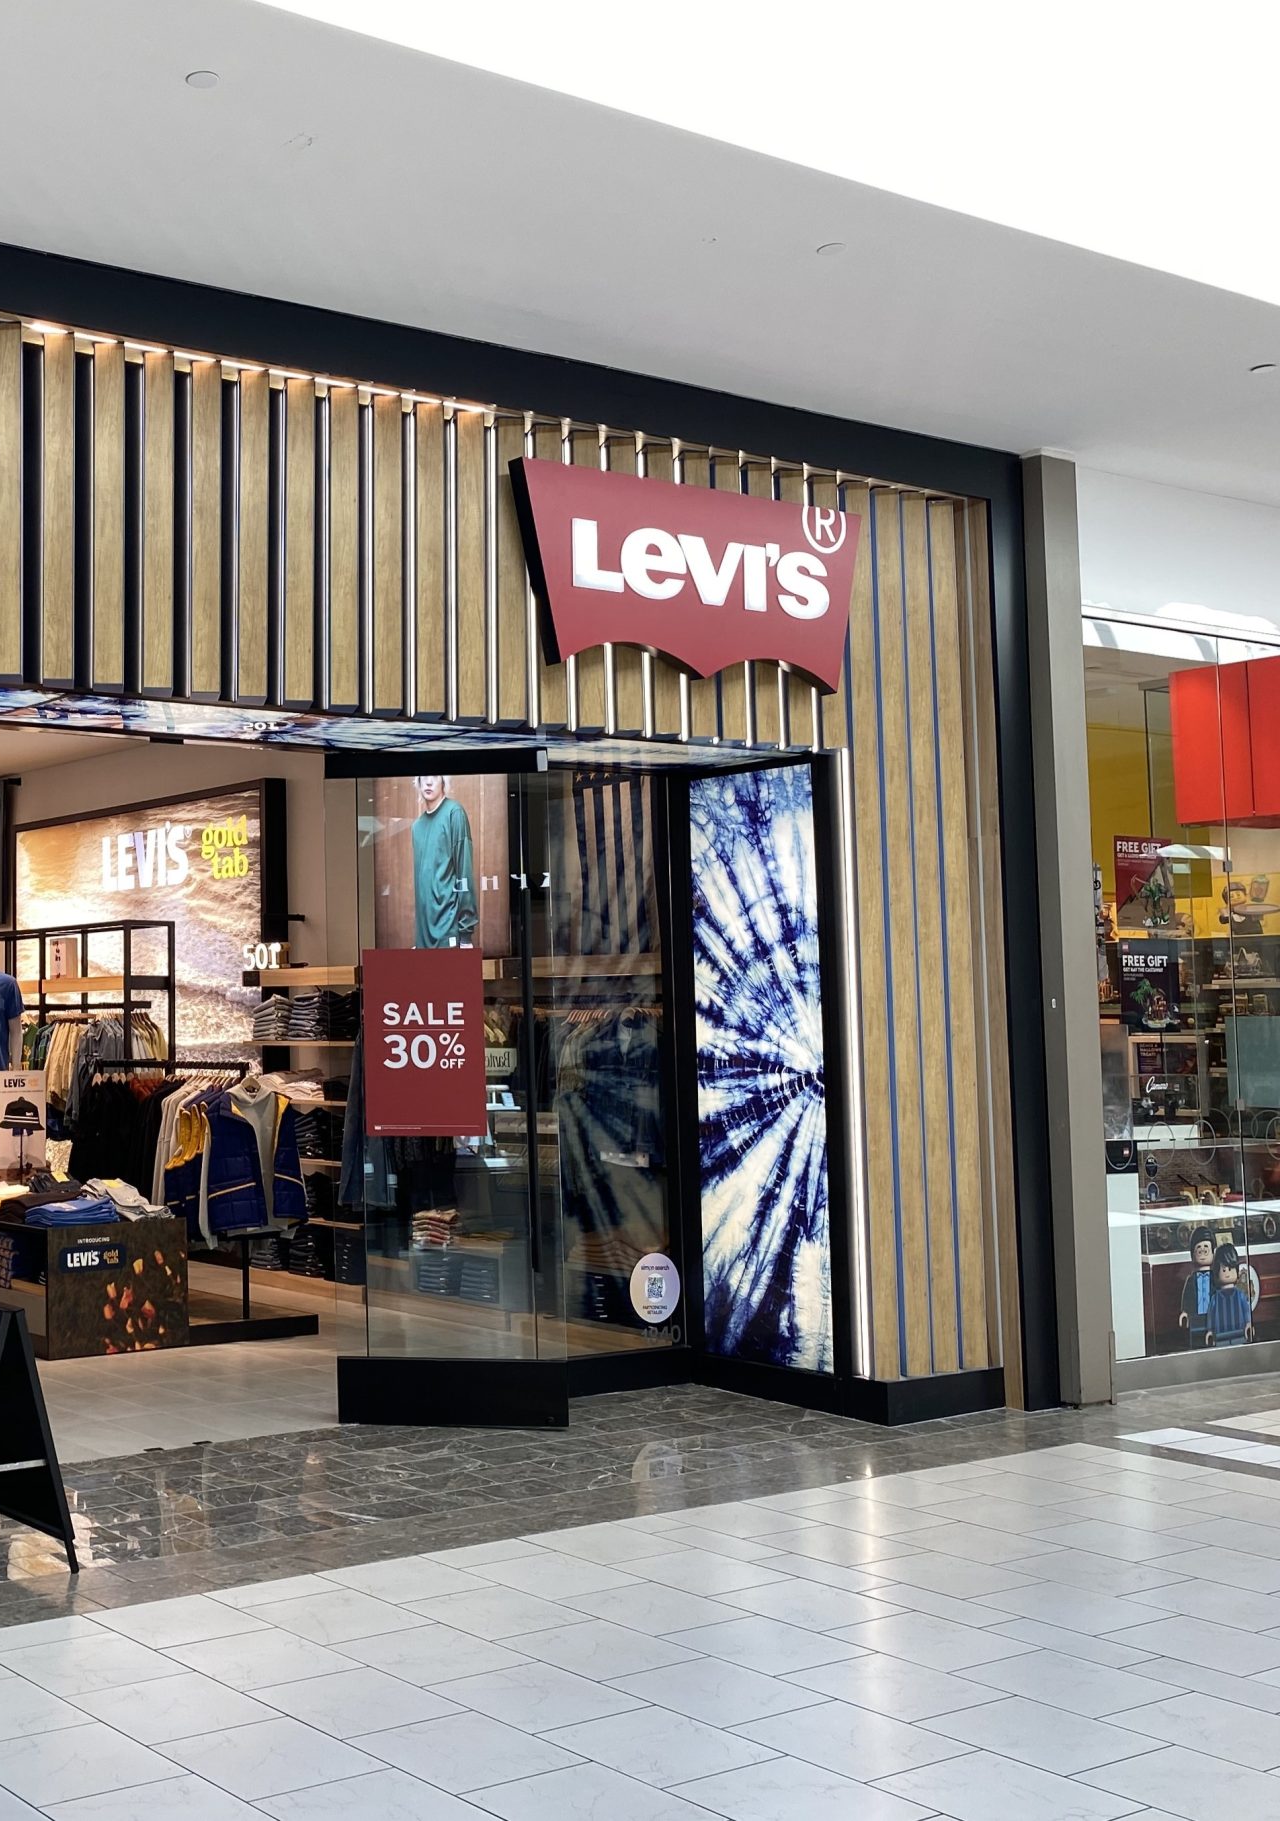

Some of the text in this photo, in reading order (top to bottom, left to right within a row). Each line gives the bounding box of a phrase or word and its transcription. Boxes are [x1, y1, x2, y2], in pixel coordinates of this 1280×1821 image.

[201, 814, 248, 859] gold
[1116, 841, 1140, 853] FREE
[211, 847, 249, 880] tab
[243, 942, 281, 970] 501
[1122, 955, 1168, 967] FREE GIFT
[383, 1002, 465, 1026] SALE
[440, 1059, 465, 1070] OFF
[77, 1236, 110, 1244] INTRODUCING
